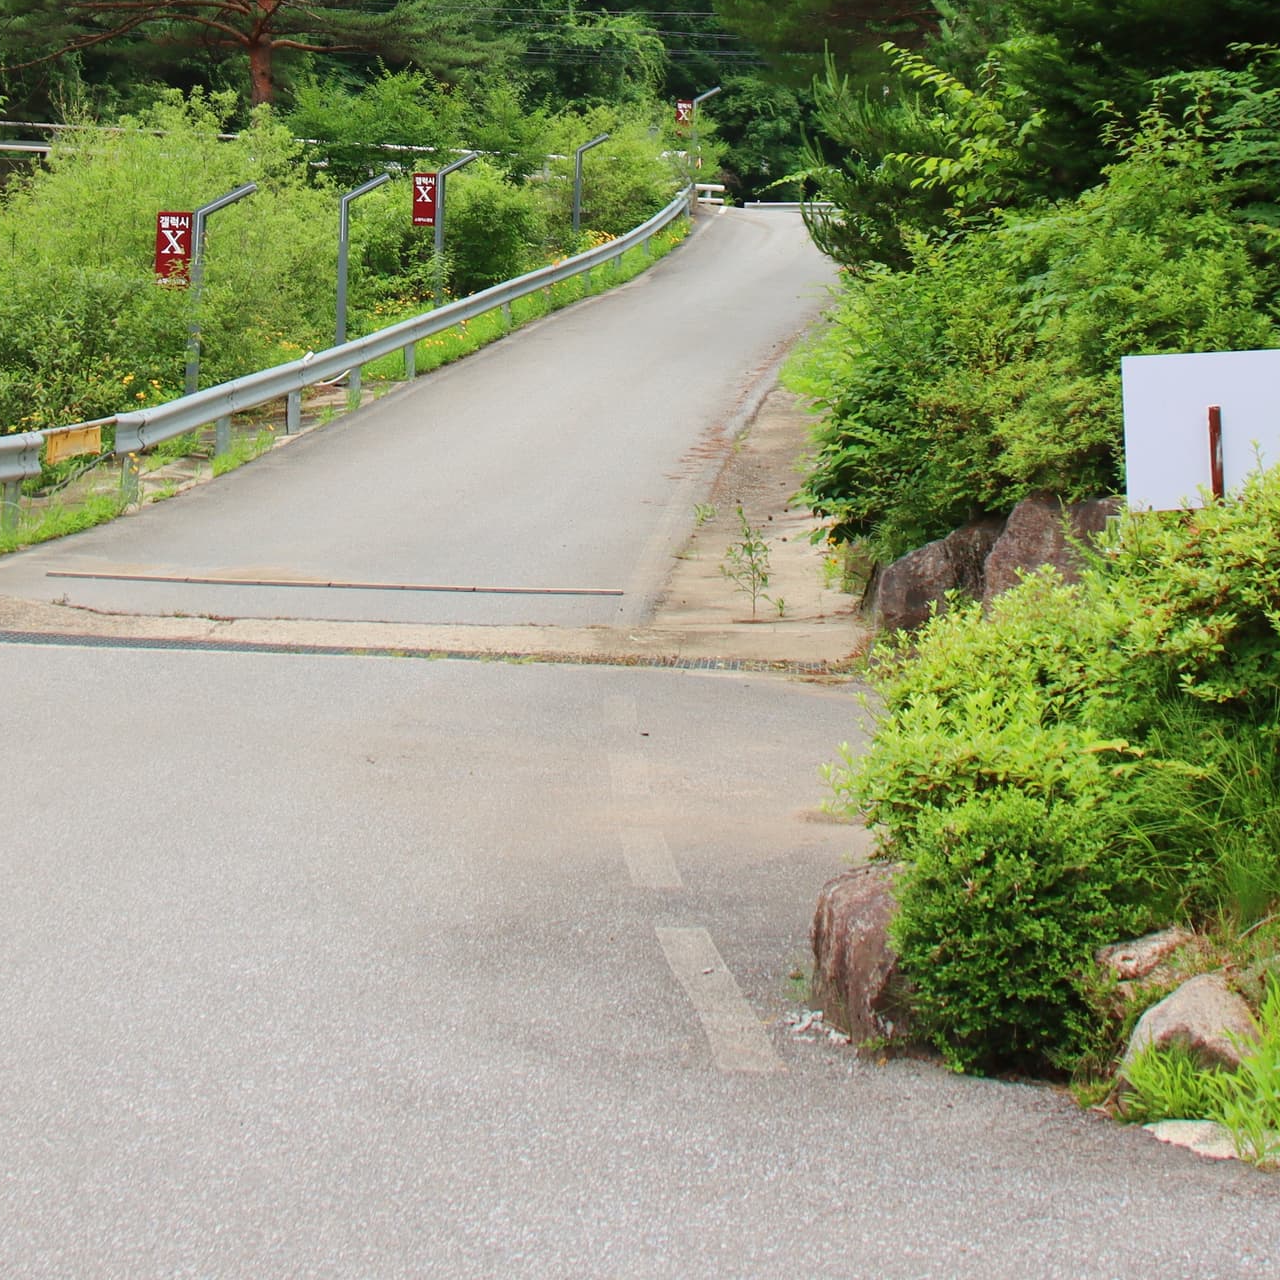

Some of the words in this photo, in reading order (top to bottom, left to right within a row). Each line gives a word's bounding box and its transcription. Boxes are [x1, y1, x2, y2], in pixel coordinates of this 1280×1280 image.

[678, 109, 689, 121] X
[416, 185, 433, 202] X
[161, 229, 186, 254] X
